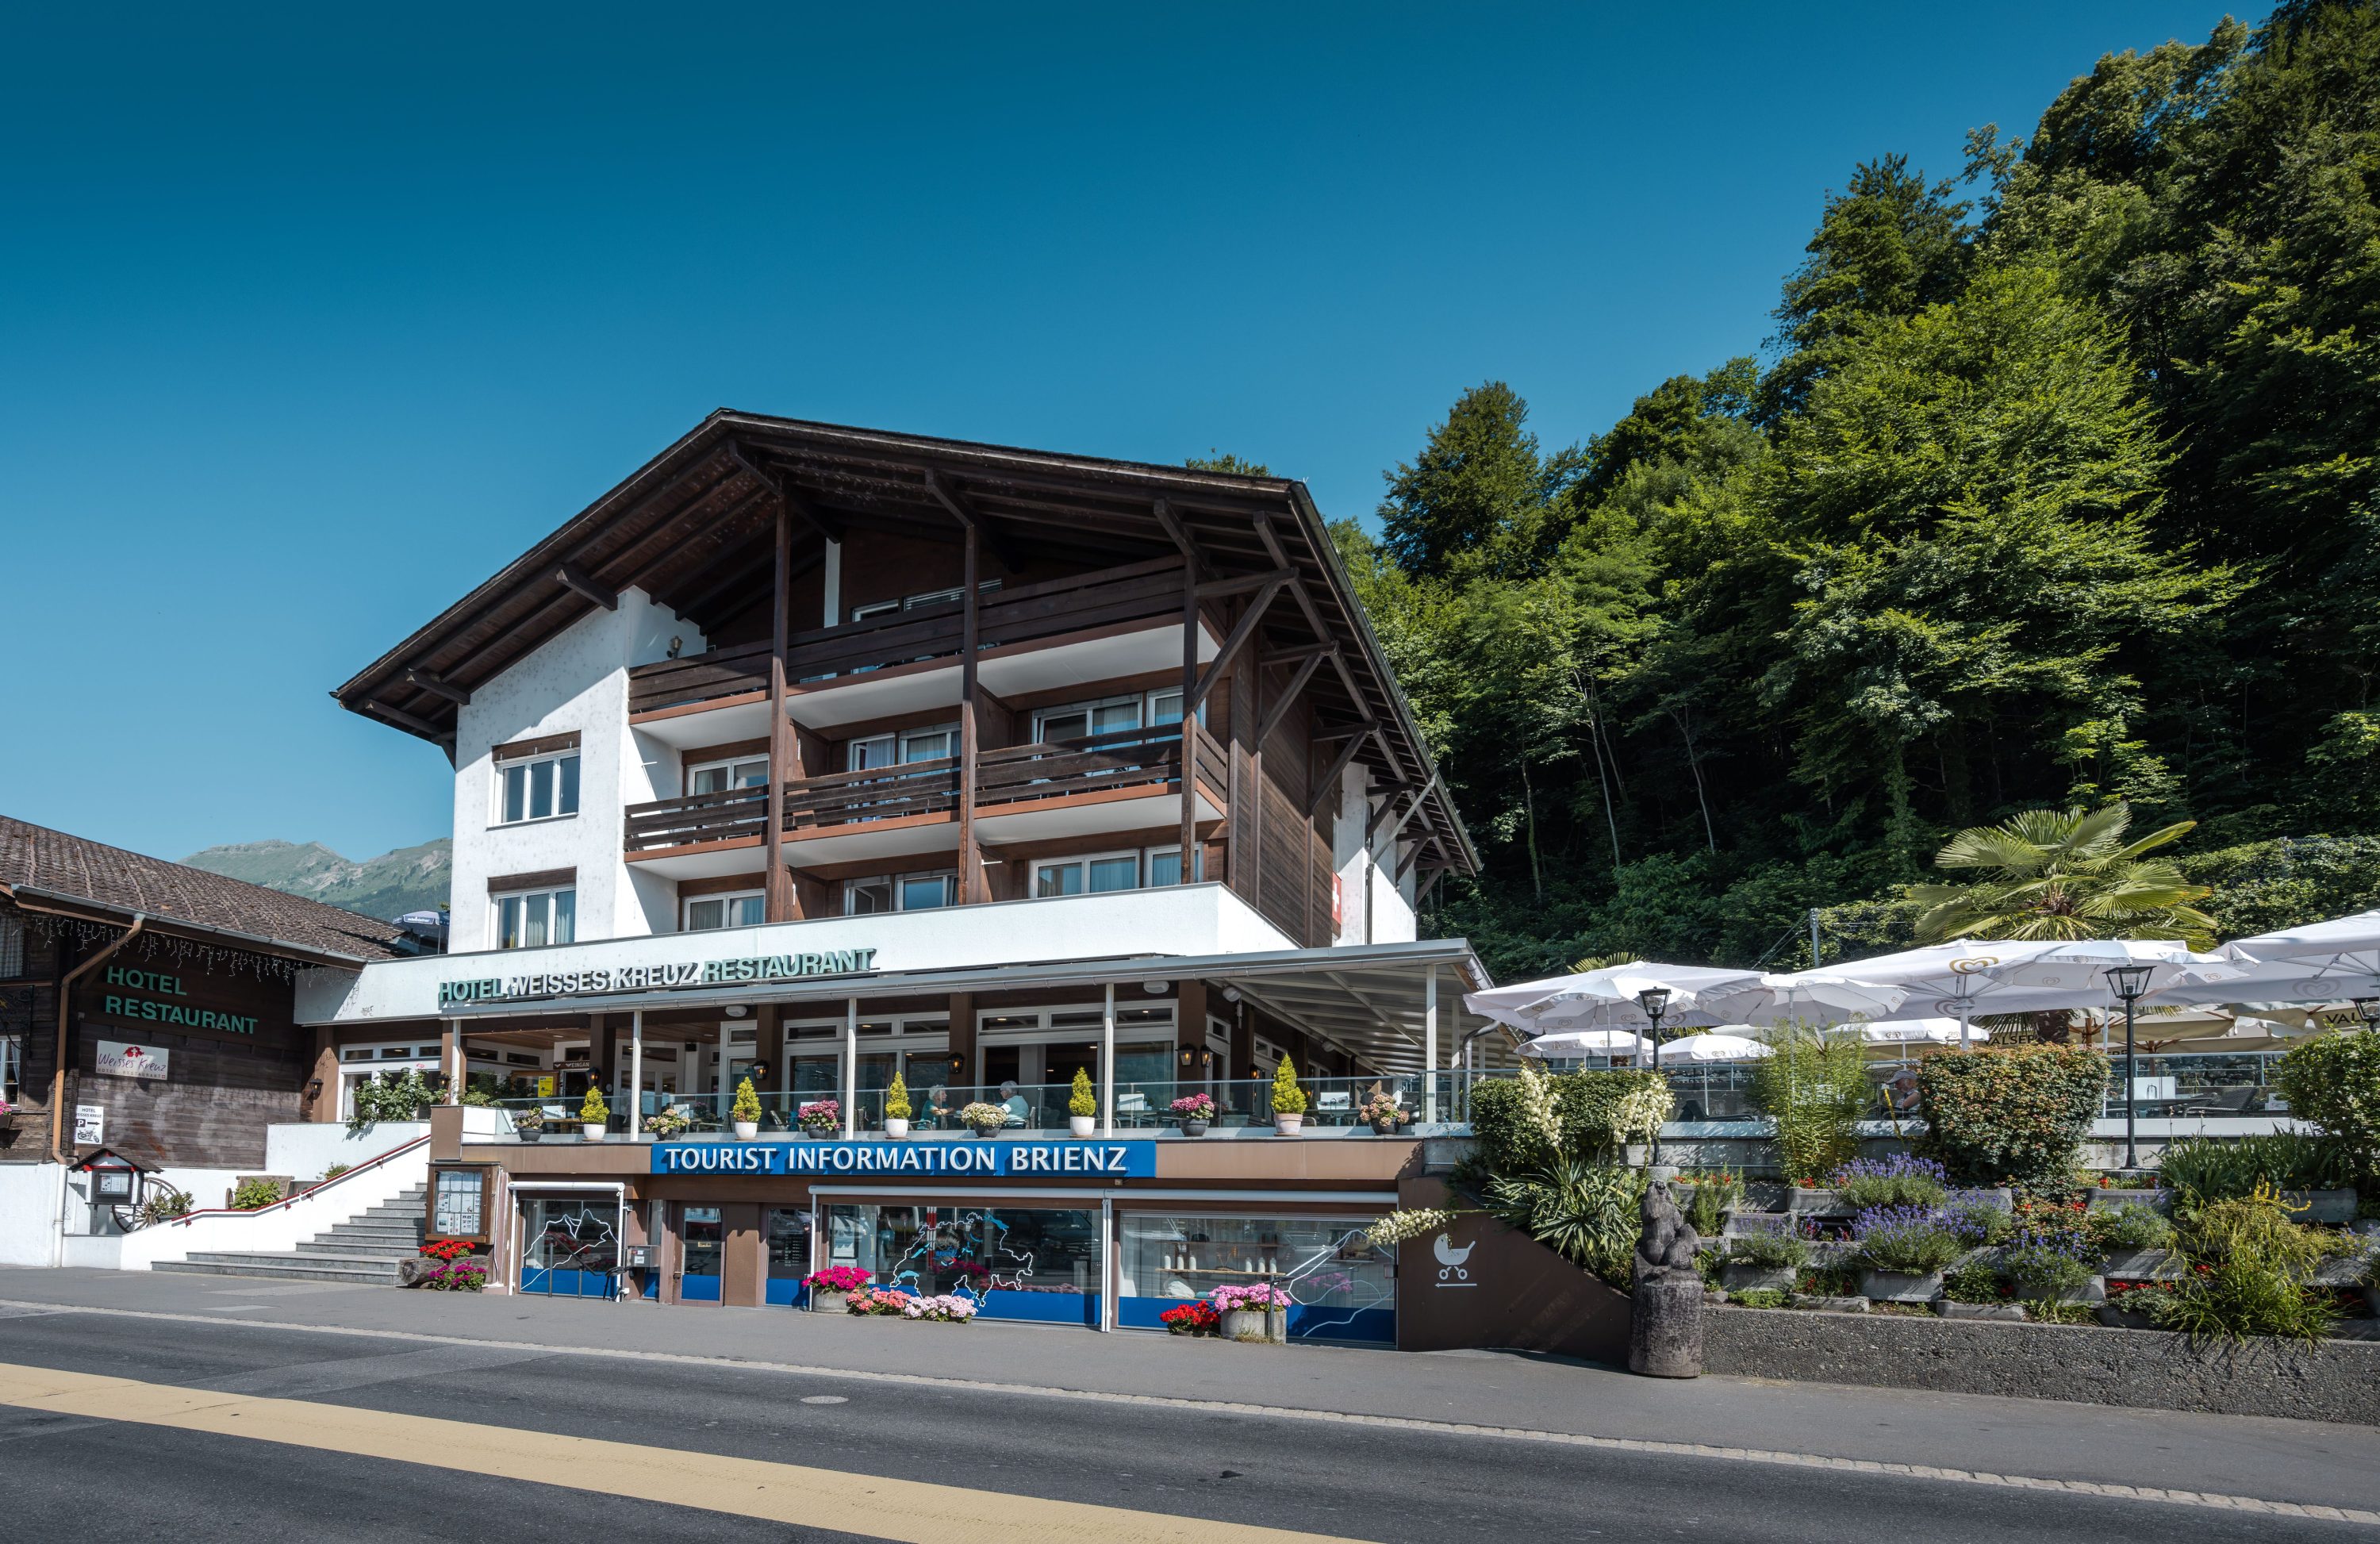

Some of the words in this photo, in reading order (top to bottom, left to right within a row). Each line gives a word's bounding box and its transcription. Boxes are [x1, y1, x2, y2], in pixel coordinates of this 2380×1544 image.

[106, 966, 187, 996] HOTEL
[440, 977, 505, 1001] HOTEL
[509, 970, 609, 996] WEISSES
[615, 962, 697, 989] KREUZ
[703, 948, 877, 982] RESTAURANT
[106, 996, 258, 1034] RESTAURANT
[2324, 1012, 2361, 1024] VAL
[98, 1053, 134, 1069] Weisses
[138, 1058, 167, 1072] Kreuz
[665, 1147, 776, 1170] TOURIST
[789, 1147, 996, 1170] INFORMATION
[1012, 1147, 1127, 1170] BRIENZ
